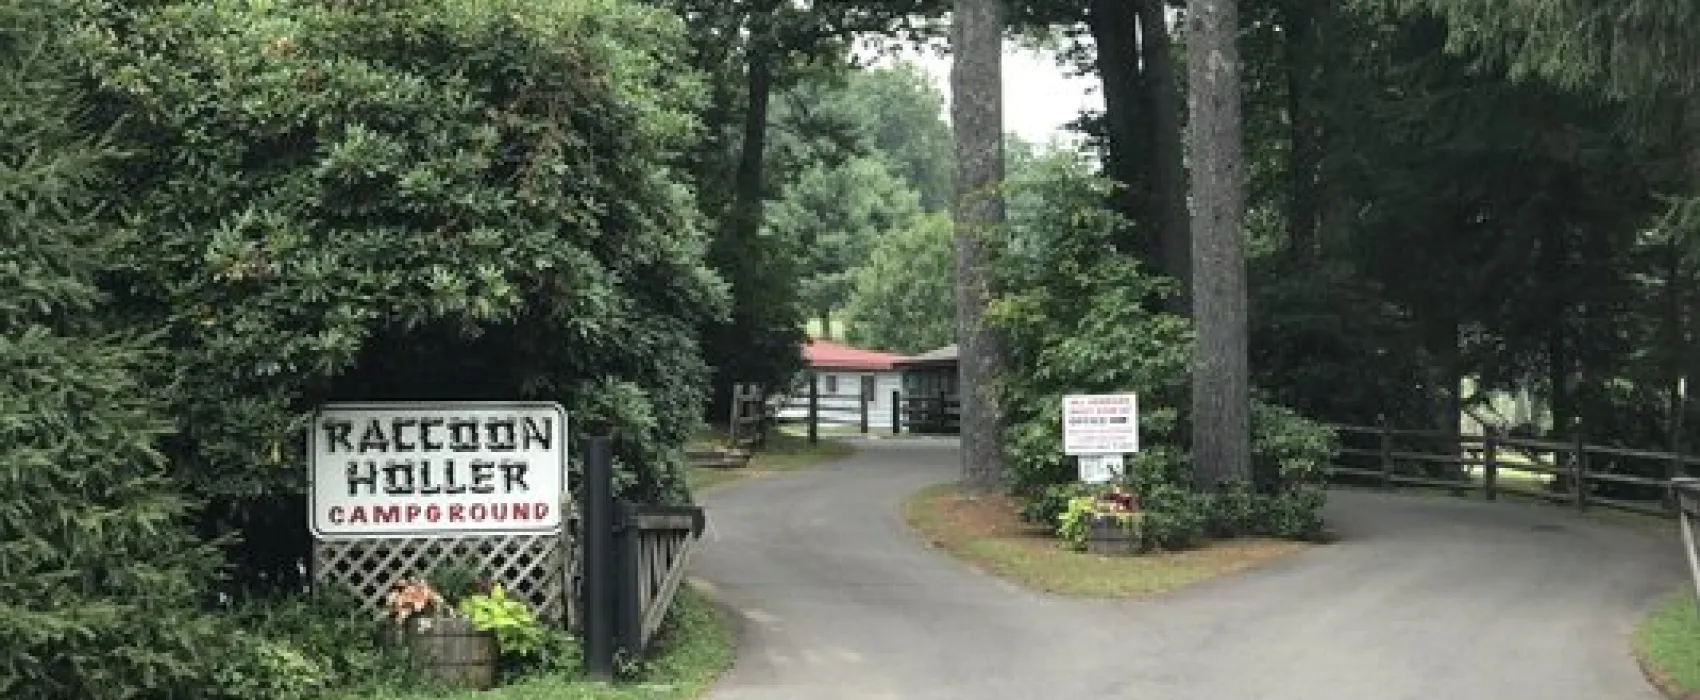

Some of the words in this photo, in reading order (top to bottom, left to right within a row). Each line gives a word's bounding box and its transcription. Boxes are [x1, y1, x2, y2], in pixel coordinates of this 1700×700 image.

[322, 417, 552, 453] RACCOON
[346, 459, 530, 496] HOLLER
[328, 503, 549, 524] CAMPGROUND
